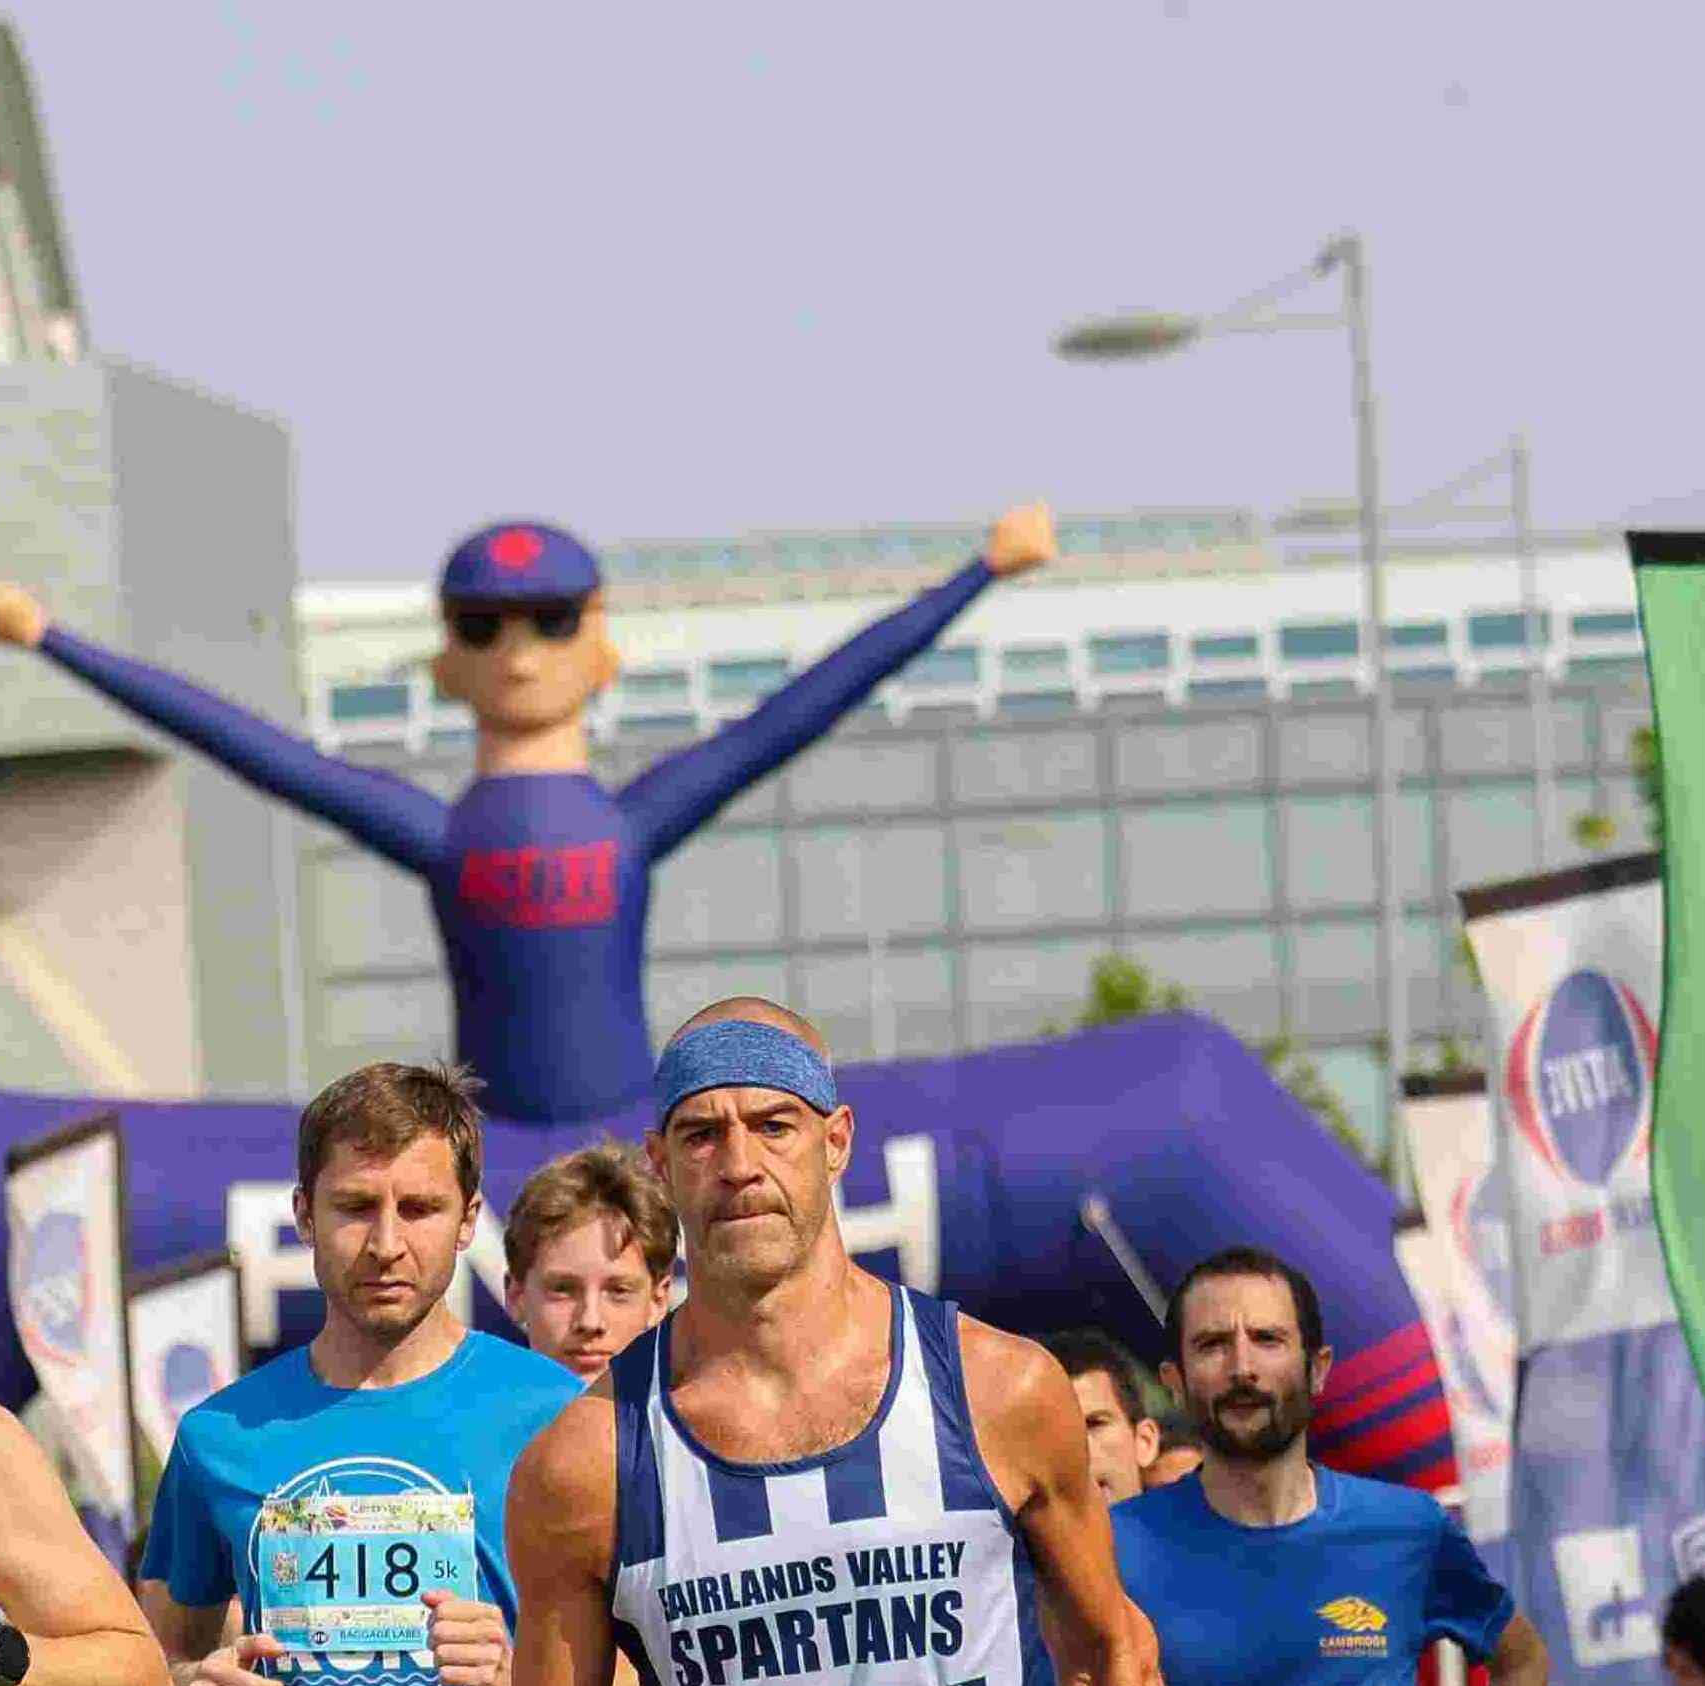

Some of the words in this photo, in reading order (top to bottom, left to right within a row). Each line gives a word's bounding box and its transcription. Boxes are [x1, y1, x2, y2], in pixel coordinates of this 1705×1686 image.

[304, 1541, 420, 1599] 418
[433, 1559, 459, 1581] 5k
[845, 1541, 966, 1588] VALLEY
